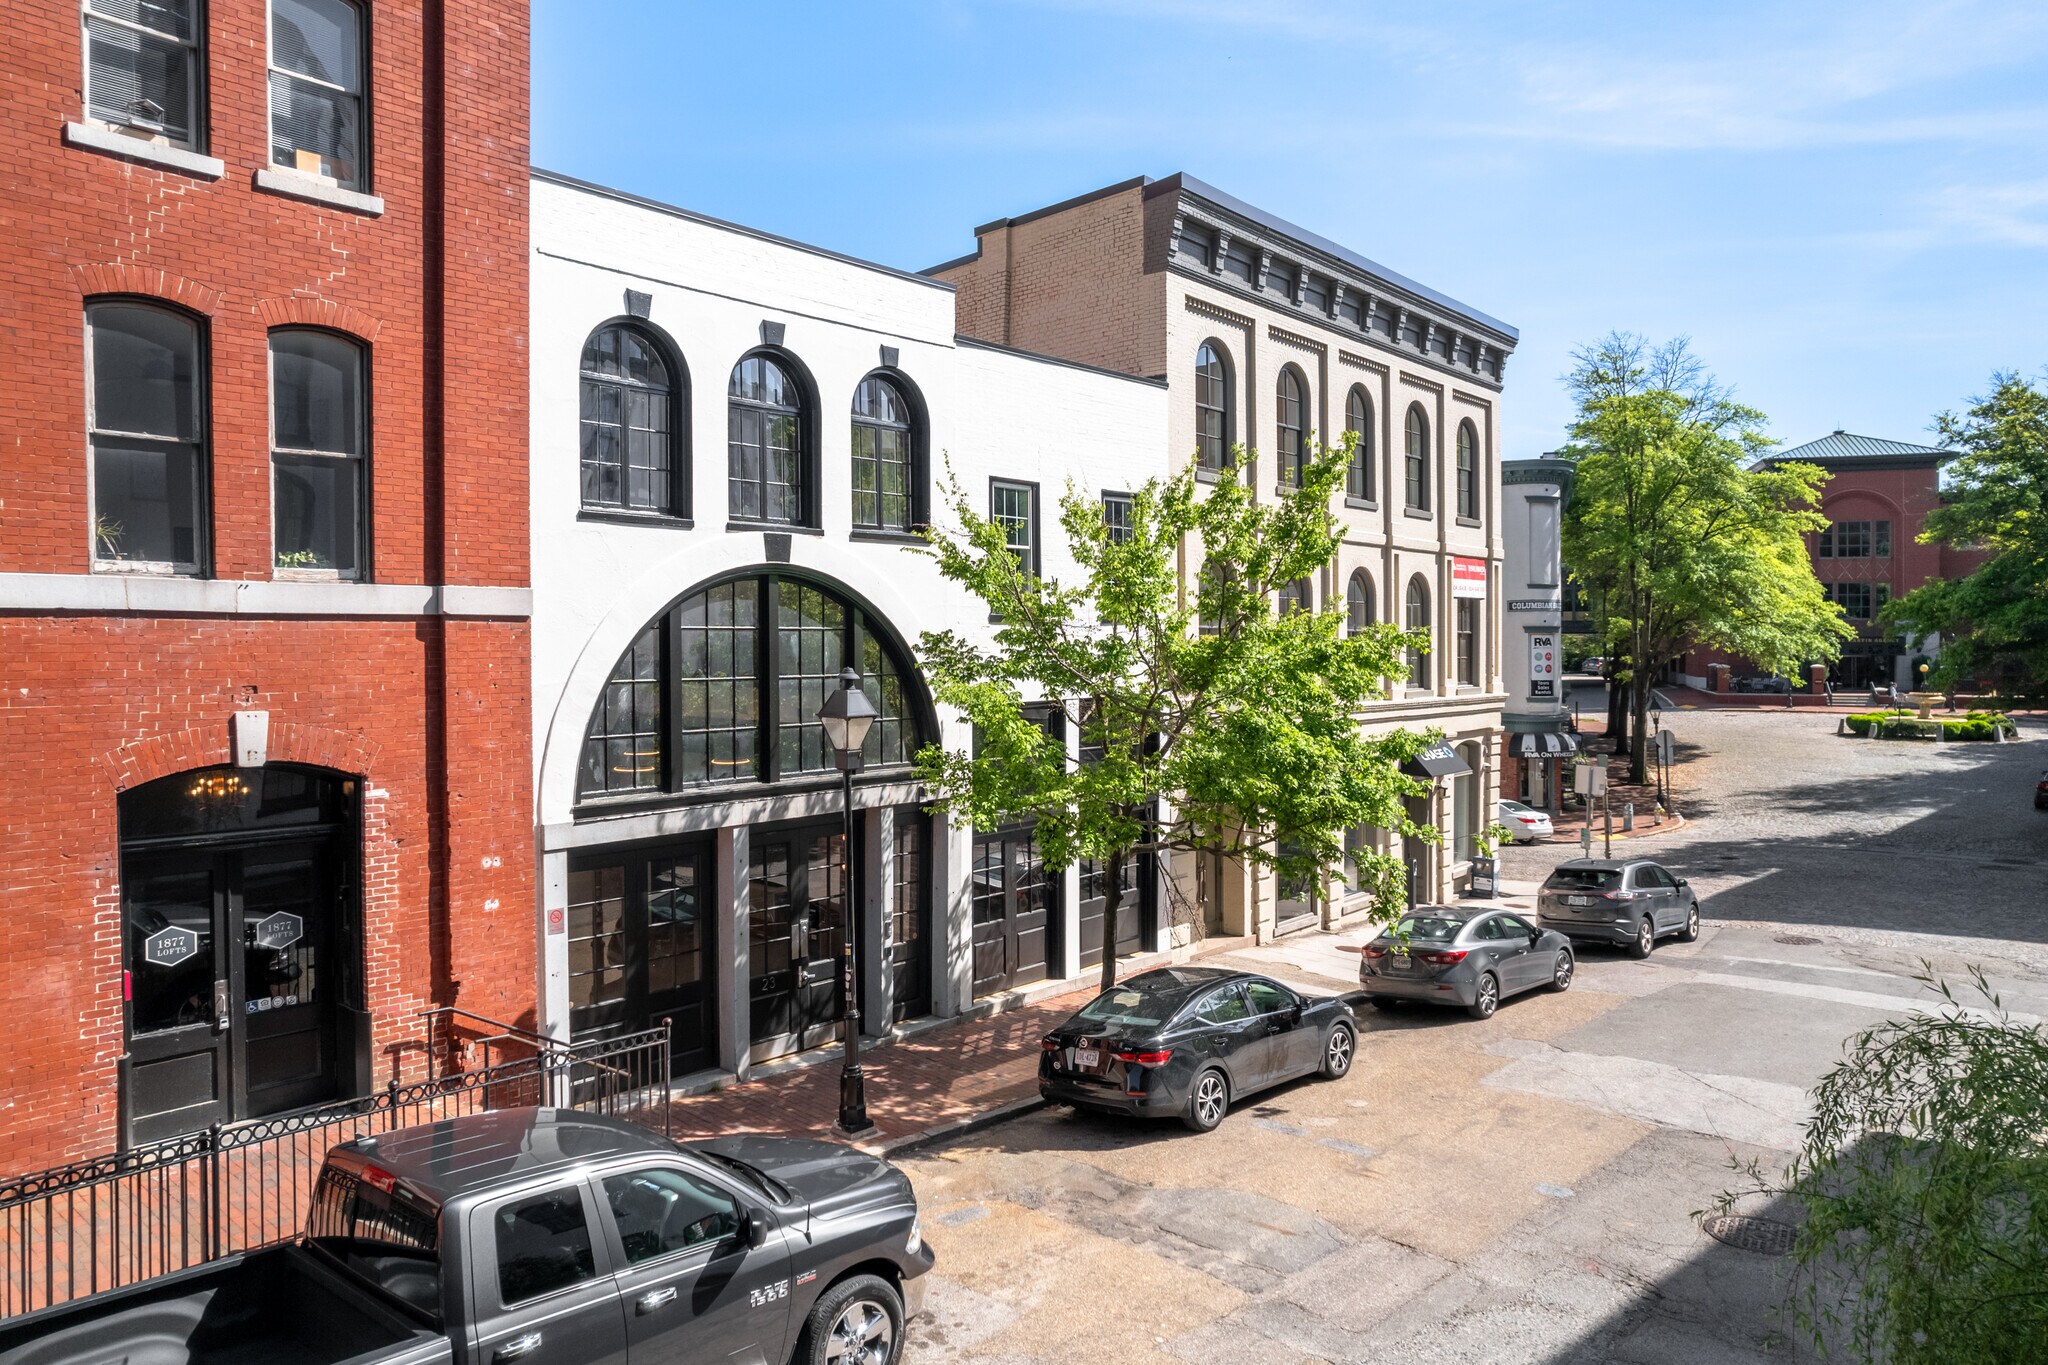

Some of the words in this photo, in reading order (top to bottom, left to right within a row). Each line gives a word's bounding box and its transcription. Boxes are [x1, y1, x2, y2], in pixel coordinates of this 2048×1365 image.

[1511, 602, 1552, 610] COLUMBIAN
[1534, 637, 1552, 647] RVA
[267, 921, 292, 933] 1877
[267, 930, 294, 940] LOFTS
[157, 936, 185, 949] 1877
[157, 946, 187, 957] LOFTS
[762, 976, 776, 991] 23
[750, 1279, 788, 1299] RAM
[750, 1288, 788, 1309] 1500
